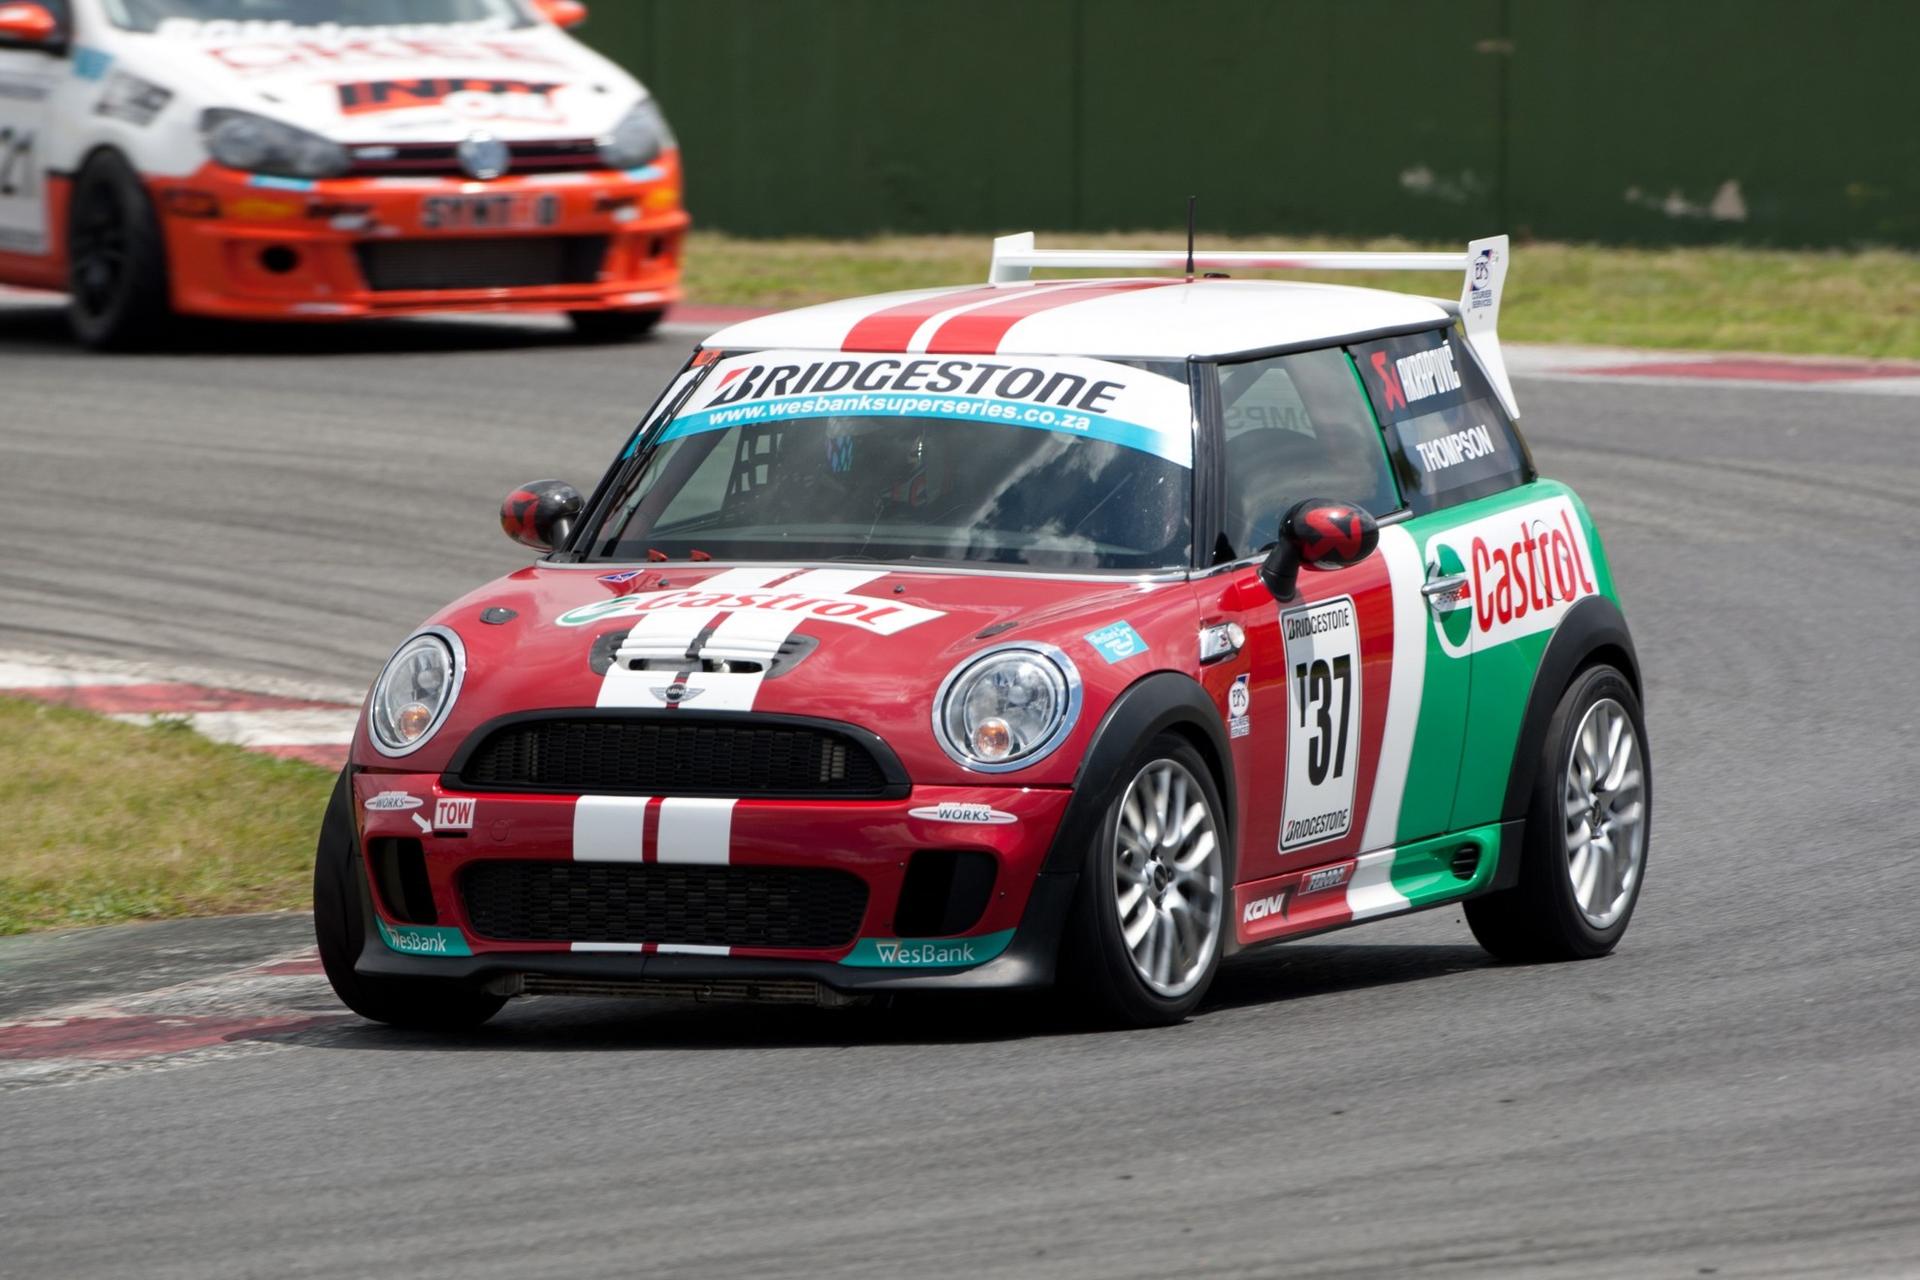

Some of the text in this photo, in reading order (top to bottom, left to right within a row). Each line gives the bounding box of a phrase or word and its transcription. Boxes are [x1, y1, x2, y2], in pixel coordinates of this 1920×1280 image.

[702, 359, 1127, 414] BRIDGESTONE
[708, 394, 1091, 431] www.wesbanksuperseries.co.za
[1416, 424, 1495, 473] THOMPSON
[1472, 509, 1594, 633] Castrol
[633, 591, 905, 626] Castrol
[1287, 608, 1350, 641] BRIDGESTONE
[1232, 688, 1246, 708] EPS
[375, 798, 405, 809] WORKS
[439, 801, 472, 825] TOW
[939, 808, 991, 821] WORKS
[1285, 809, 1349, 842] BRIDGESTONE
[1243, 893, 1286, 923] KONI
[390, 930, 446, 952] WesBank
[876, 943, 975, 963] WesBank
